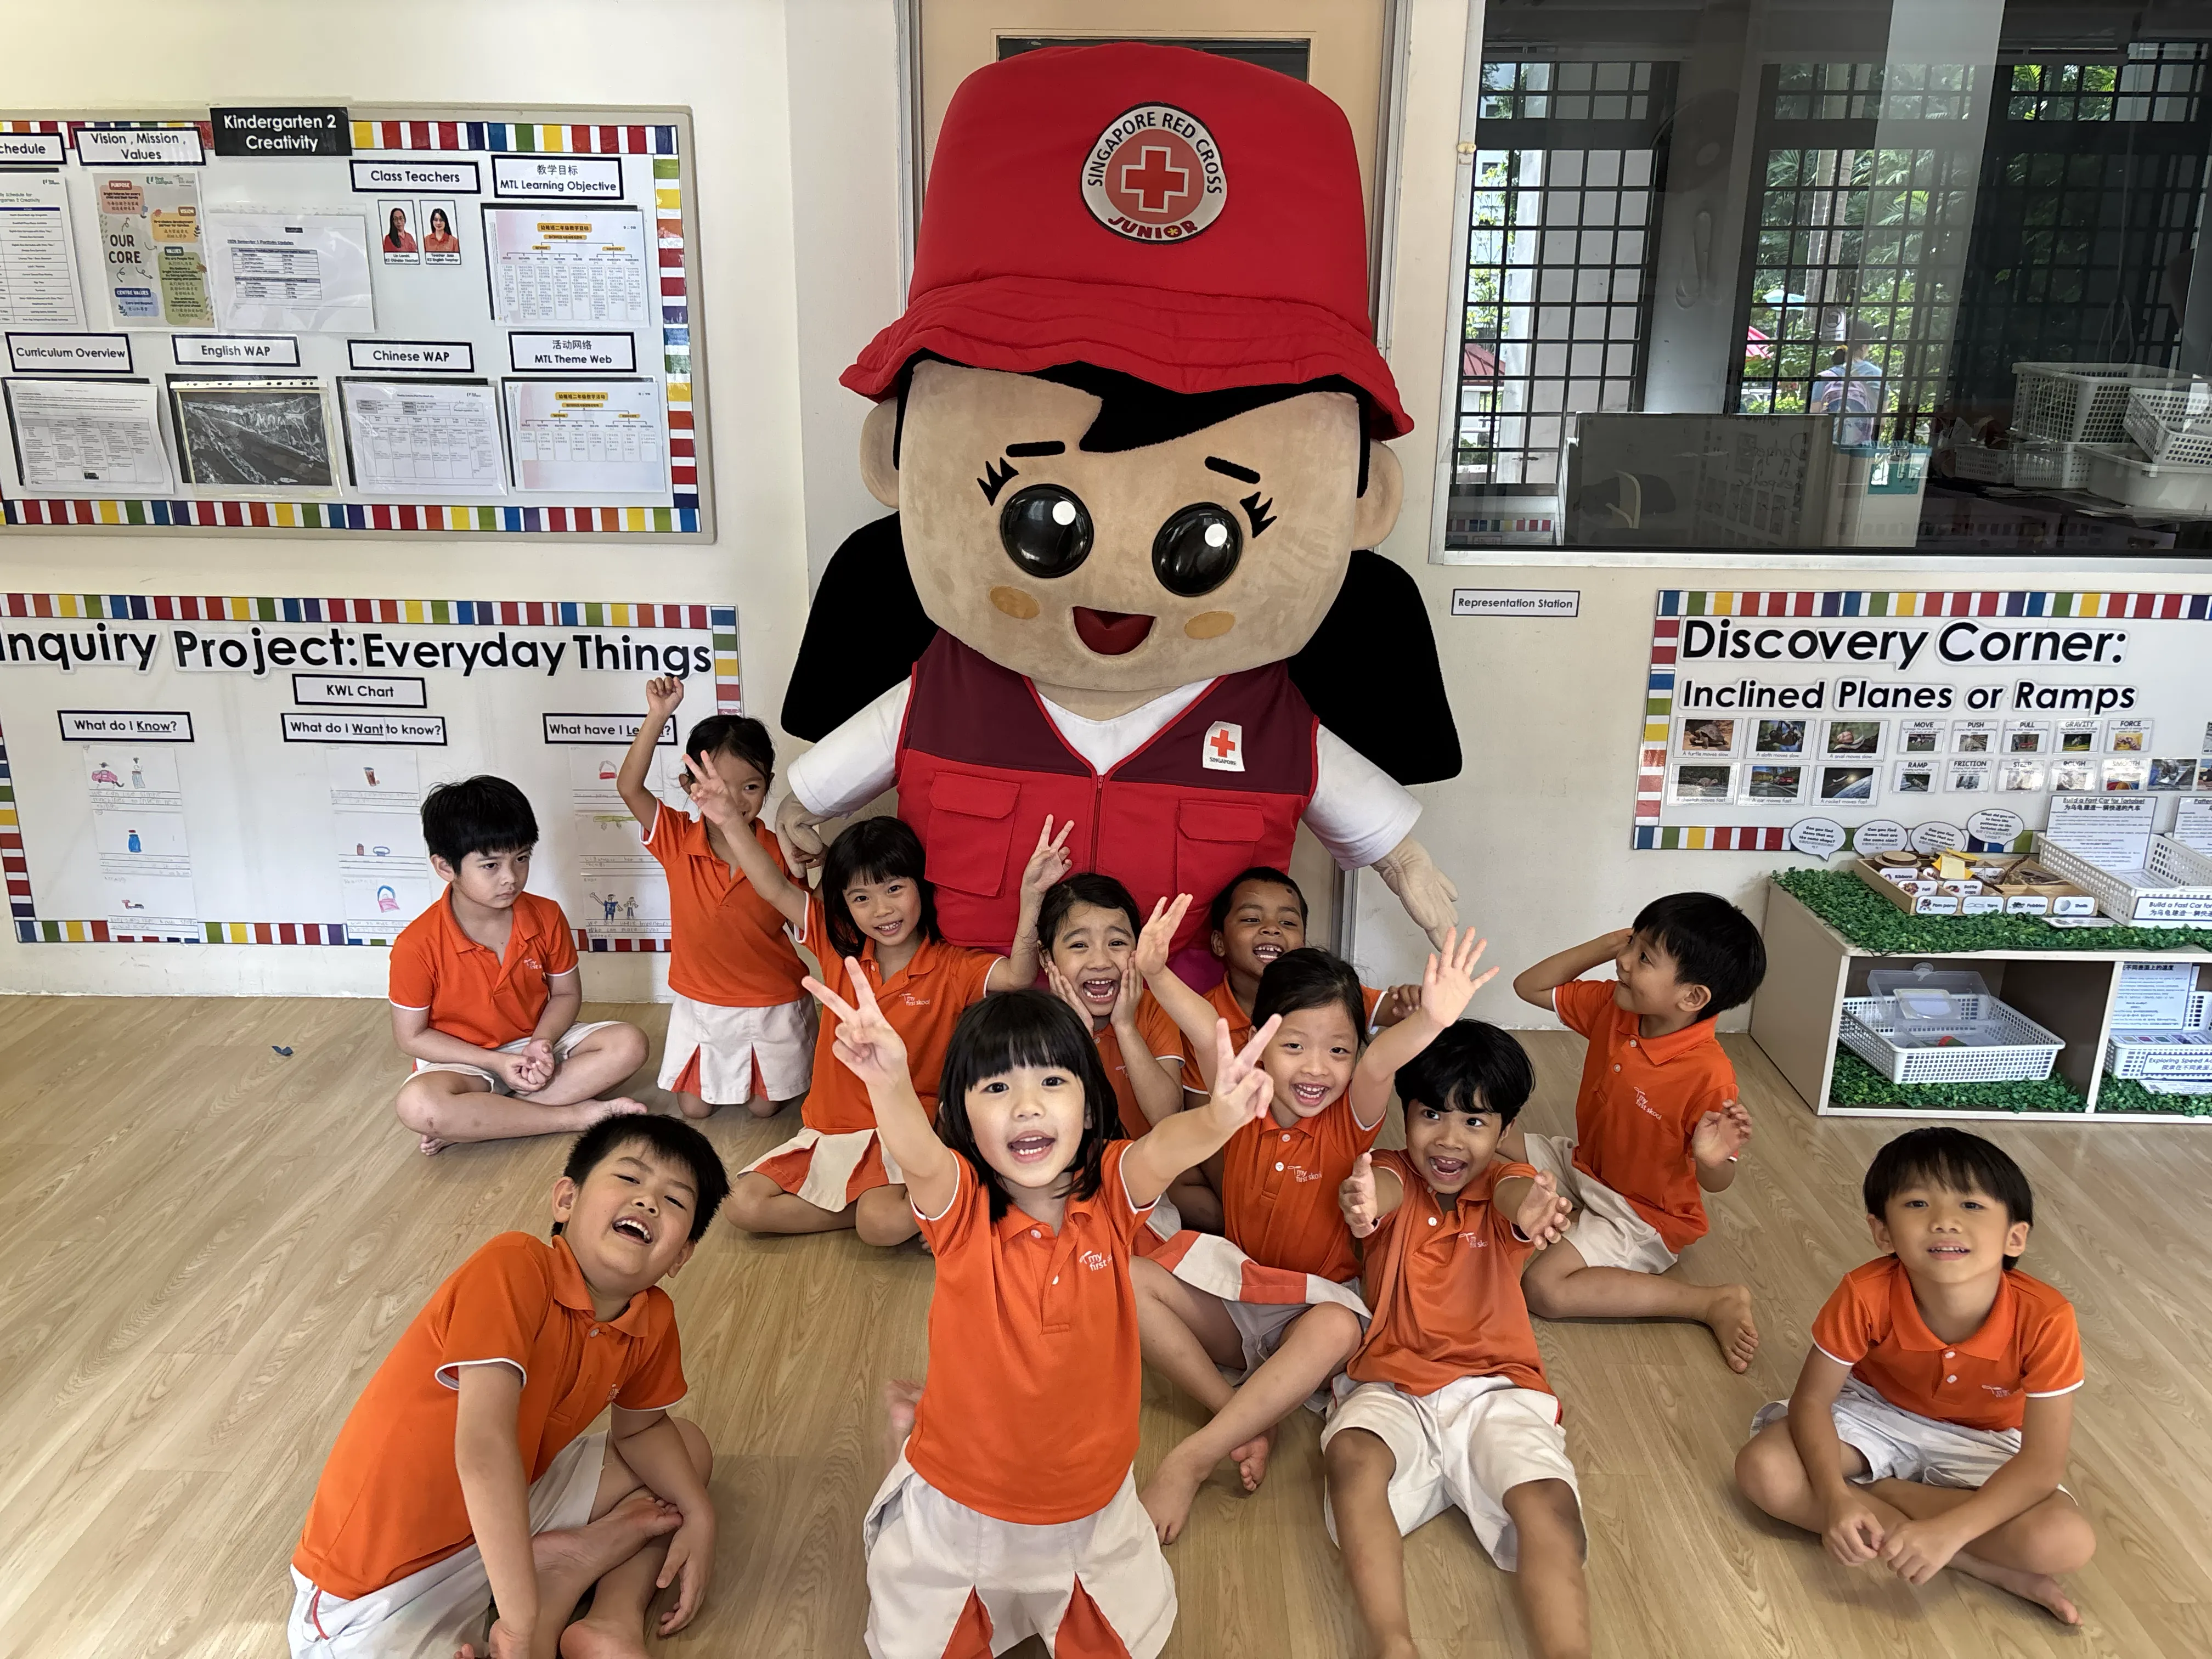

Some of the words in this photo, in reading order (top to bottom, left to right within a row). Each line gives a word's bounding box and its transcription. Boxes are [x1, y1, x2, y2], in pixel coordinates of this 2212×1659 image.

[224, 115, 323, 131] Kindergarten
[328, 115, 336, 128] 2
[91, 133, 127, 144] Vision
[137, 133, 179, 144] Mission
[246, 135, 318, 152] Creativity
[121, 149, 161, 159] Values
[1087, 111, 1156, 187] SINGAPORE
[1162, 112, 1196, 138] RED
[1196, 139, 1222, 194] CROSS
[537, 165, 578, 176] 教学目标
[370, 171, 402, 182] Class
[405, 171, 460, 183] Teachers
[500, 180, 518, 189] MTL
[522, 180, 564, 192] Learning
[567, 181, 617, 192] Objective
[1108, 216, 1198, 239] JUNIOR
[110, 235, 134, 247] OUR
[109, 251, 142, 263] CORE
[552, 339, 592, 351] 活动网络
[16, 347, 73, 358] Curriculum
[76, 347, 126, 359] Overview
[201, 345, 241, 358] English
[244, 346, 270, 357] WAP
[373, 350, 420, 362] Chinese
[423, 352, 449, 363] WAP
[534, 354, 552, 363] MTL
[554, 354, 586, 364] Theme
[590, 355, 612, 364] Web
[1458, 598, 1535, 608] Representation
[1538, 599, 1572, 608] Station
[1683, 618, 1929, 670] Discovery
[1939, 622, 2126, 663] Corner:
[572, 634, 712, 680] Things
[327, 685, 353, 696] KWL
[358, 685, 394, 697] Chart
[1684, 680, 1825, 708] Inclined
[1838, 681, 1952, 709] Planes
[1967, 687, 2003, 709] or
[2016, 682, 2135, 715] Ramps
[74, 720, 106, 730] What
[110, 720, 126, 731] do
[130, 721, 133, 730] I
[137, 721, 177, 731] Know?
[290, 722, 321, 732] What
[325, 723, 342, 733] do
[346, 723, 348, 733] I
[352, 724, 383, 734] Want
[386, 724, 398, 734] to
[402, 725, 441, 735] know?
[549, 724, 580, 734] What
[585, 725, 615, 735] have
[619, 725, 623, 735] I
[1209, 757, 1237, 765] SINGAPORE
[1639, 1095, 1648, 1104] my
[1646, 1108, 1662, 1120] skool
[1088, 1252, 1102, 1263] my
[1090, 1259, 1107, 1272] first
